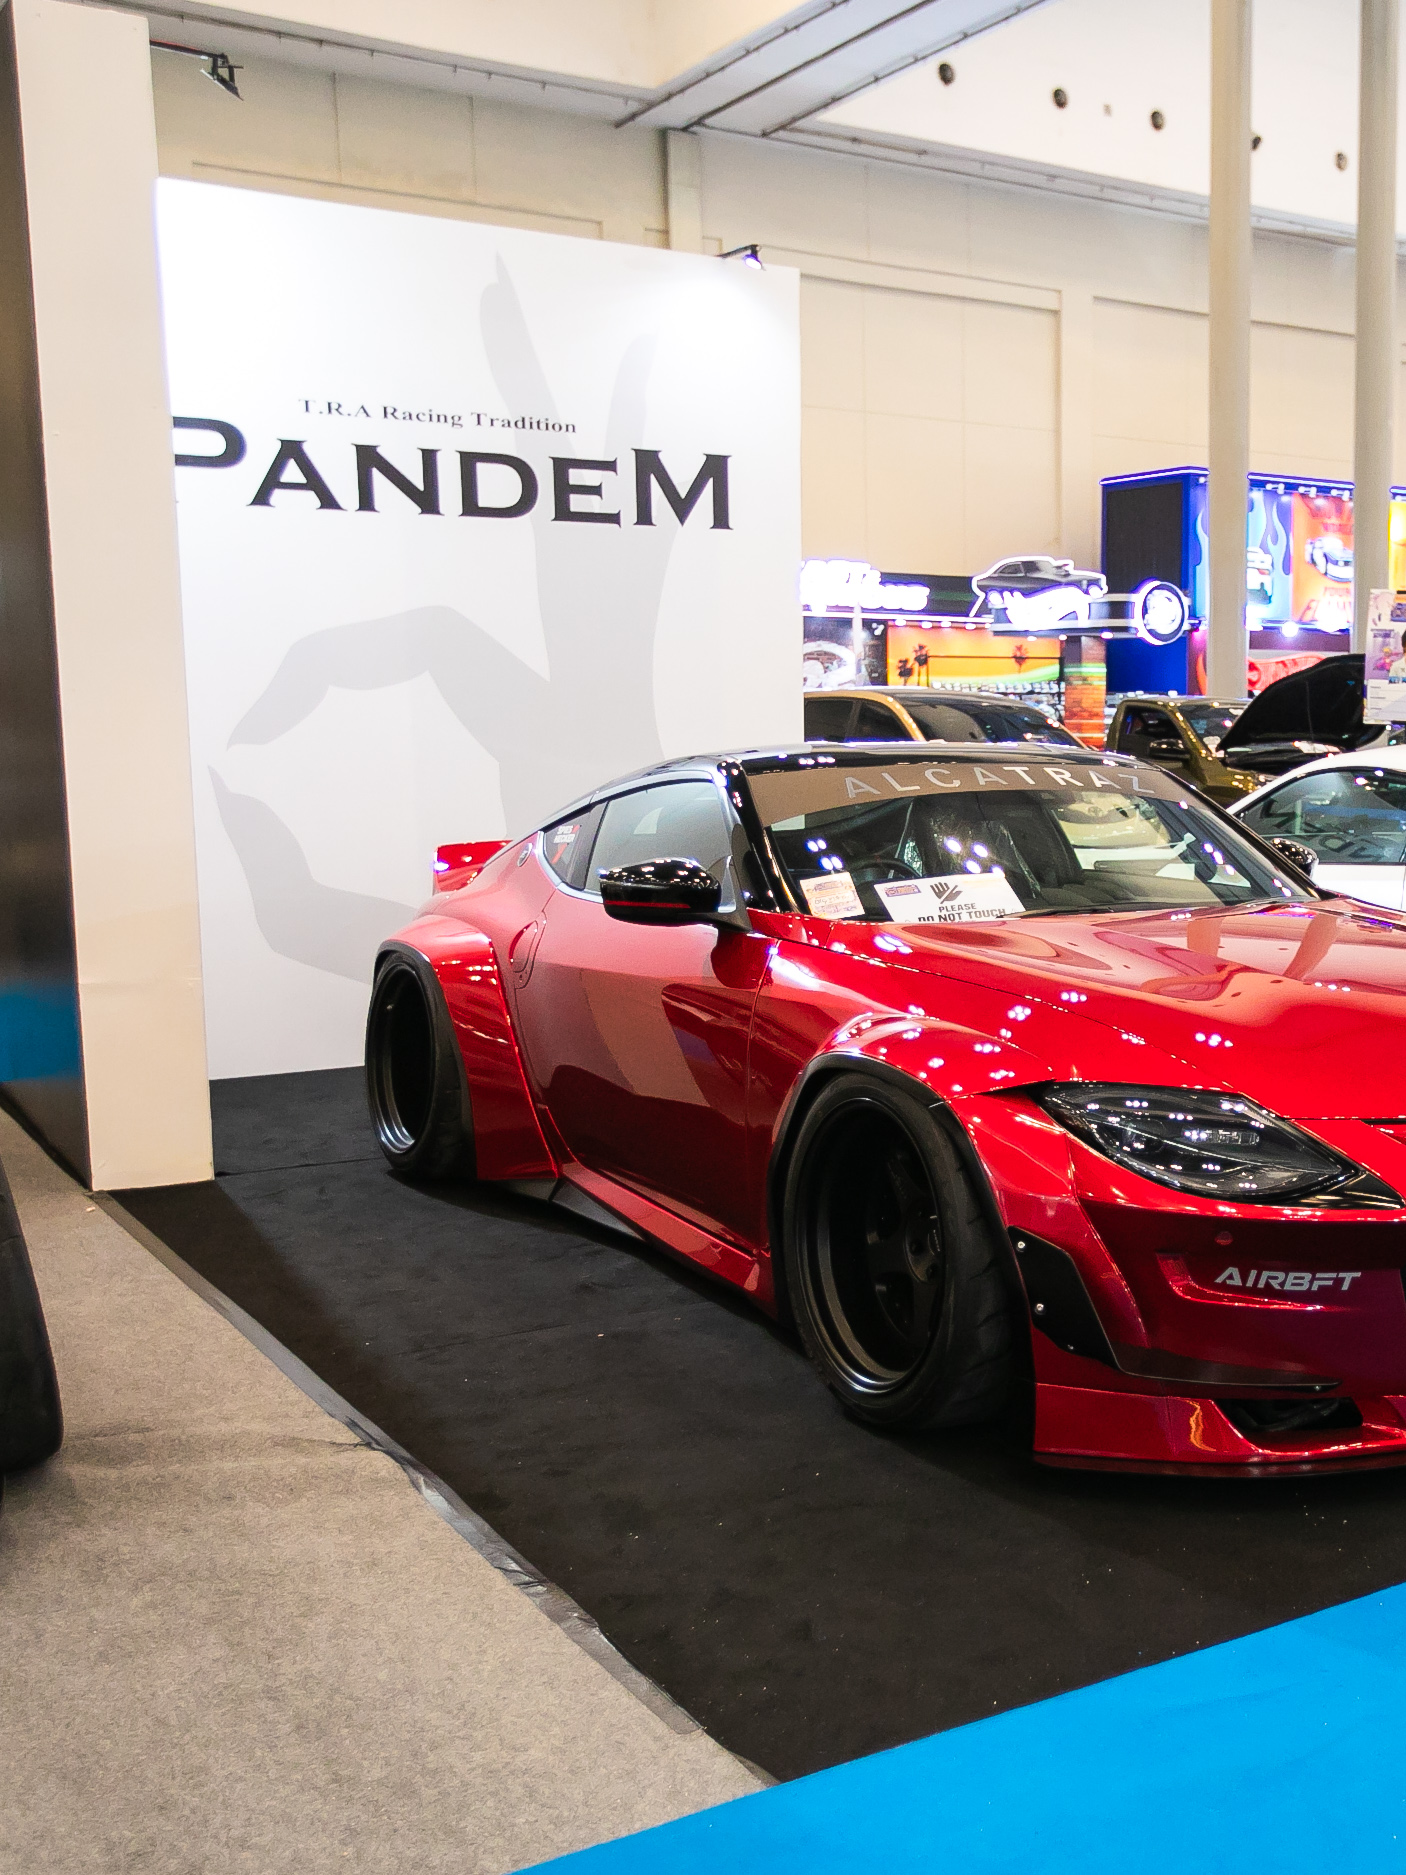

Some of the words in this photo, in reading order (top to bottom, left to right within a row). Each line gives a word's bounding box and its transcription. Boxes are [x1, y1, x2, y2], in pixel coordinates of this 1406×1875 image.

[299, 399, 371, 419] T.R.A
[383, 405, 463, 429] Racing
[471, 412, 577, 433] Tradition
[845, 766, 1155, 799] ALCATRAZ
[938, 902, 977, 913] PLEASE
[938, 912, 962, 922] NOT
[966, 908, 1006, 919] TOUCH
[1214, 1266, 1361, 1291] AIRBFT
